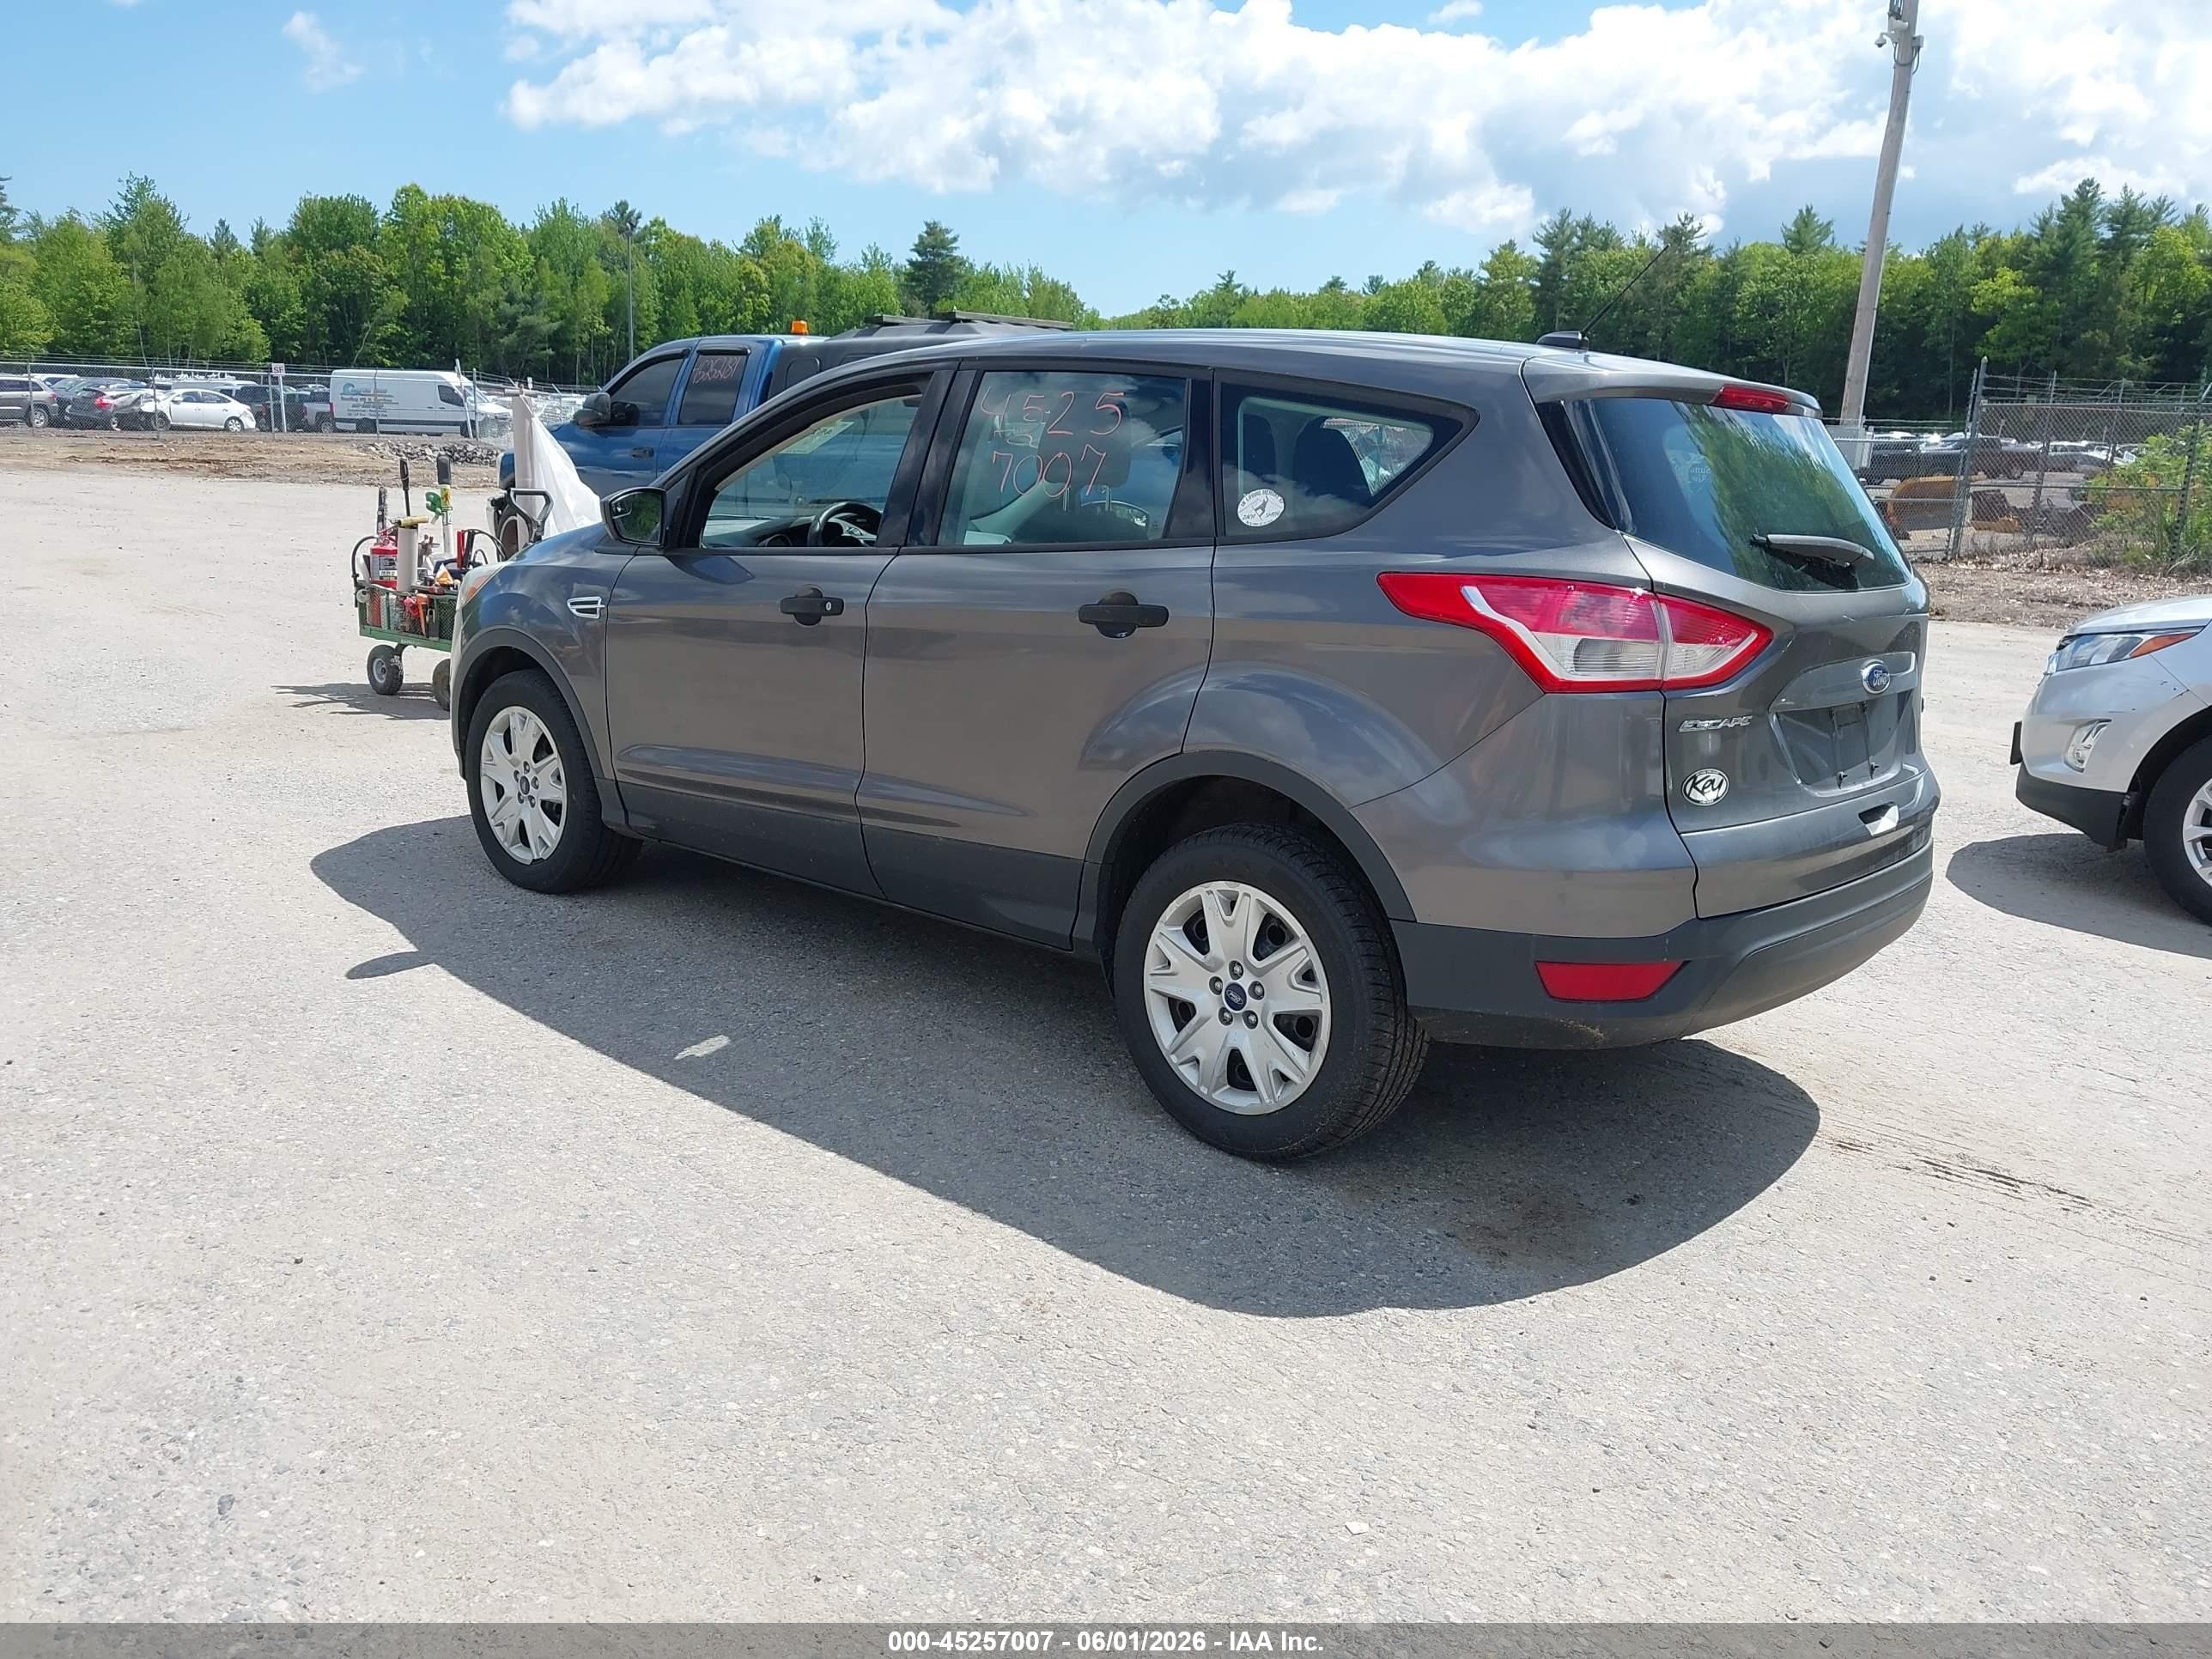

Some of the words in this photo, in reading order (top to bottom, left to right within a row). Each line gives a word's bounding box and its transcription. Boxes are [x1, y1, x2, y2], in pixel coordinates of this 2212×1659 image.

[981, 386, 1126, 435] 4525
[992, 444, 1107, 498] 7007
[1678, 715, 1753, 732] ESCAPE
